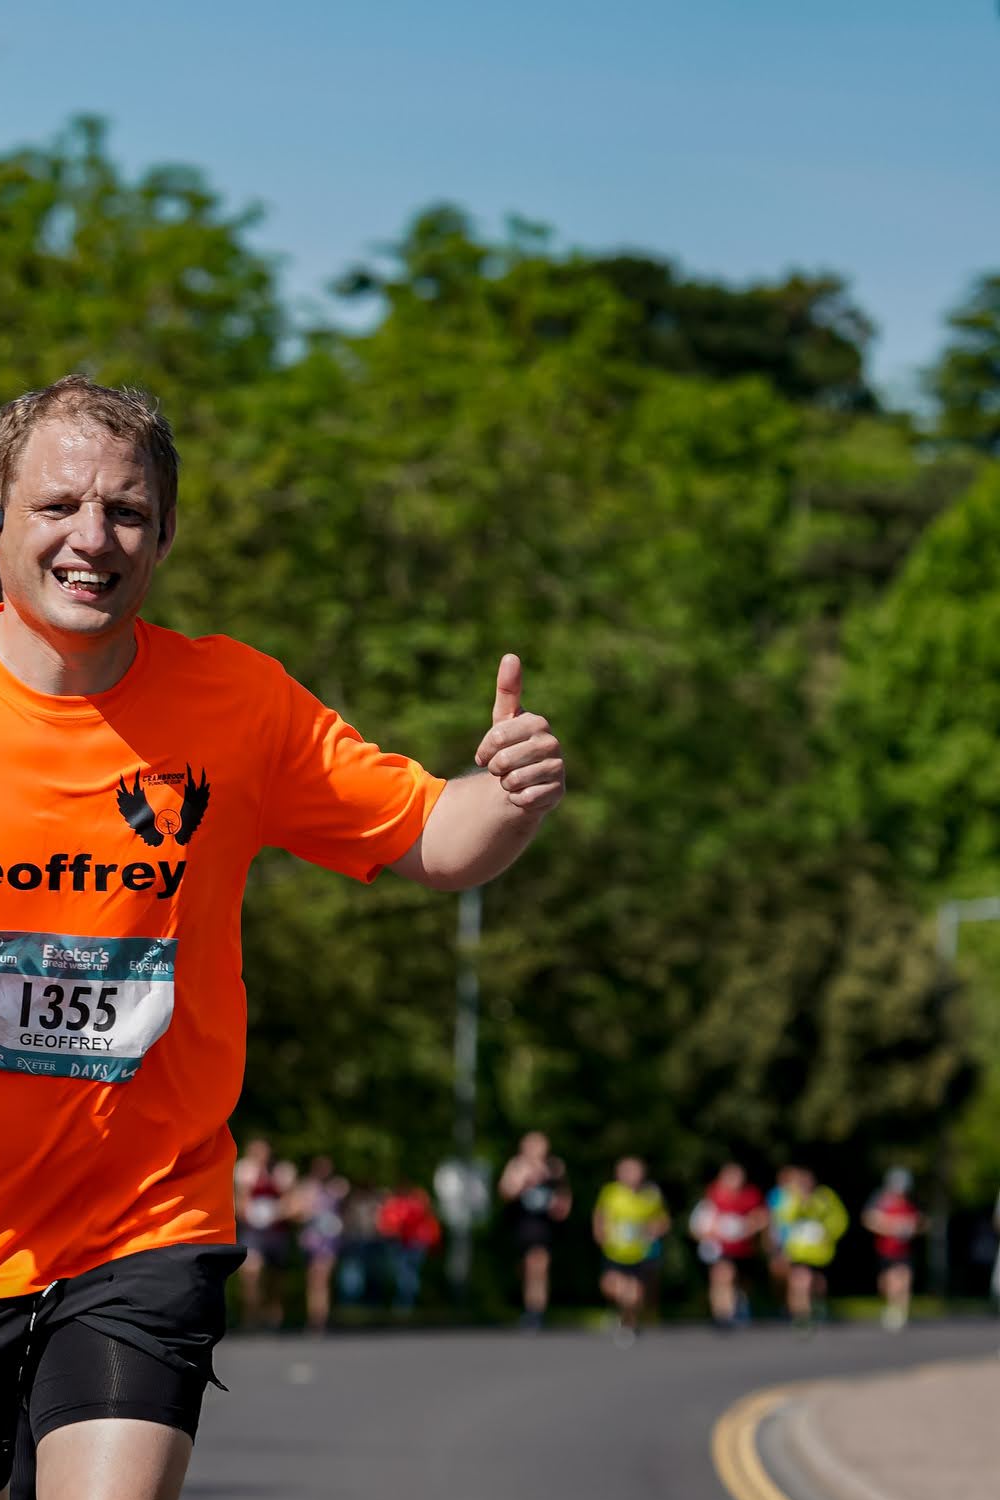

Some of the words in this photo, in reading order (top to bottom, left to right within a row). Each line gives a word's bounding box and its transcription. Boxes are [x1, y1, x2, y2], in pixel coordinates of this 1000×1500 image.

[43, 944, 109, 963] Exeter's
[42, 959, 67, 970] great
[69, 962, 91, 970] west
[92, 963, 108, 971] run
[19, 982, 118, 1032] 1355
[20, 1033, 114, 1051] GEOFFREY
[16, 1057, 57, 1075] EXETER
[70, 1062, 108, 1080] DAYS
